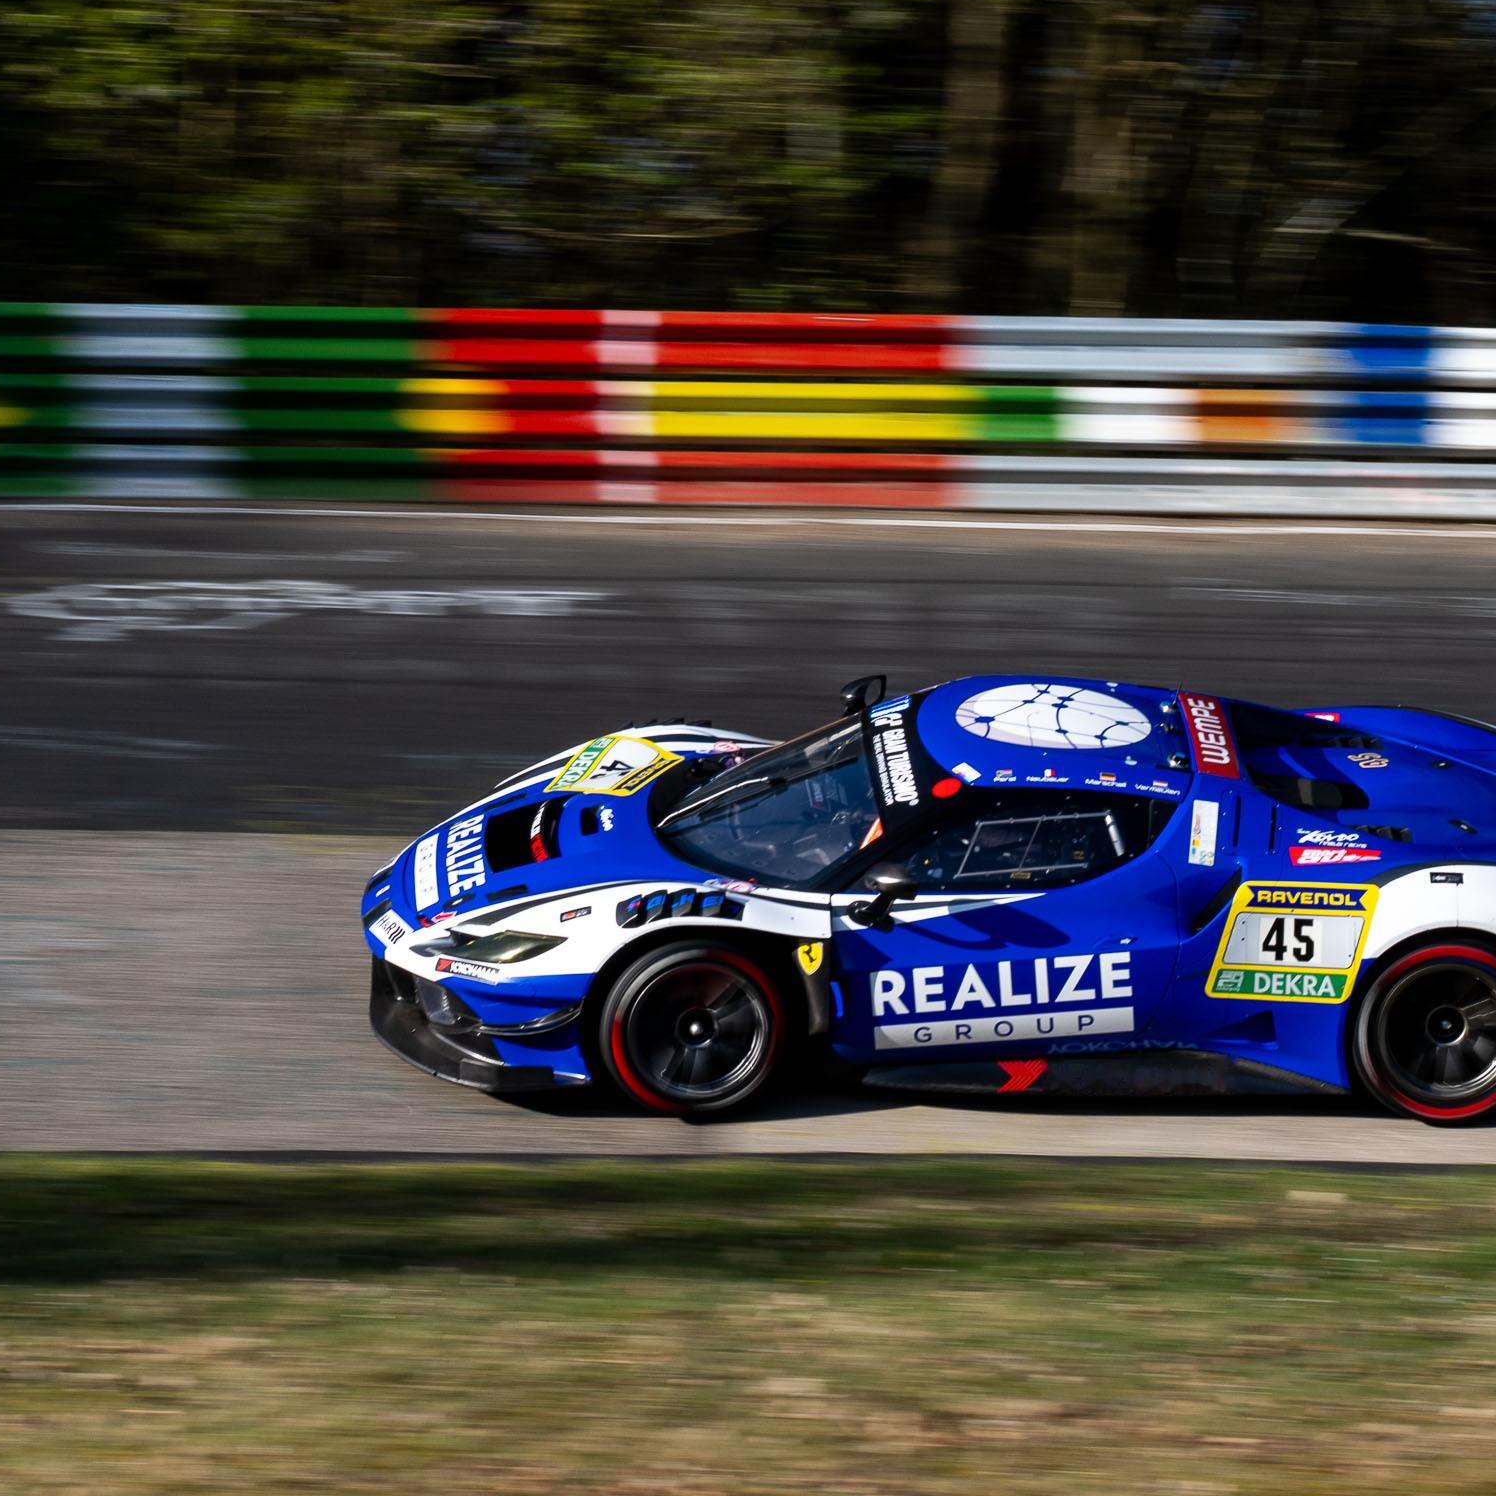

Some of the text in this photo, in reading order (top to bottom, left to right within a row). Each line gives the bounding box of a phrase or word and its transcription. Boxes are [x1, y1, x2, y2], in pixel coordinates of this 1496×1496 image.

[882, 728, 908, 754] GRAN
[1187, 698, 1231, 765] WEMPE
[886, 751, 919, 803] TURISMO
[446, 814, 486, 898] REALIZE
[1257, 890, 1358, 906] RAVENOL
[1262, 917, 1315, 962] 45
[870, 952, 1133, 1017] REALIZE
[1254, 972, 1336, 997] DEKRA
[914, 1015, 1095, 1043] GROUP
